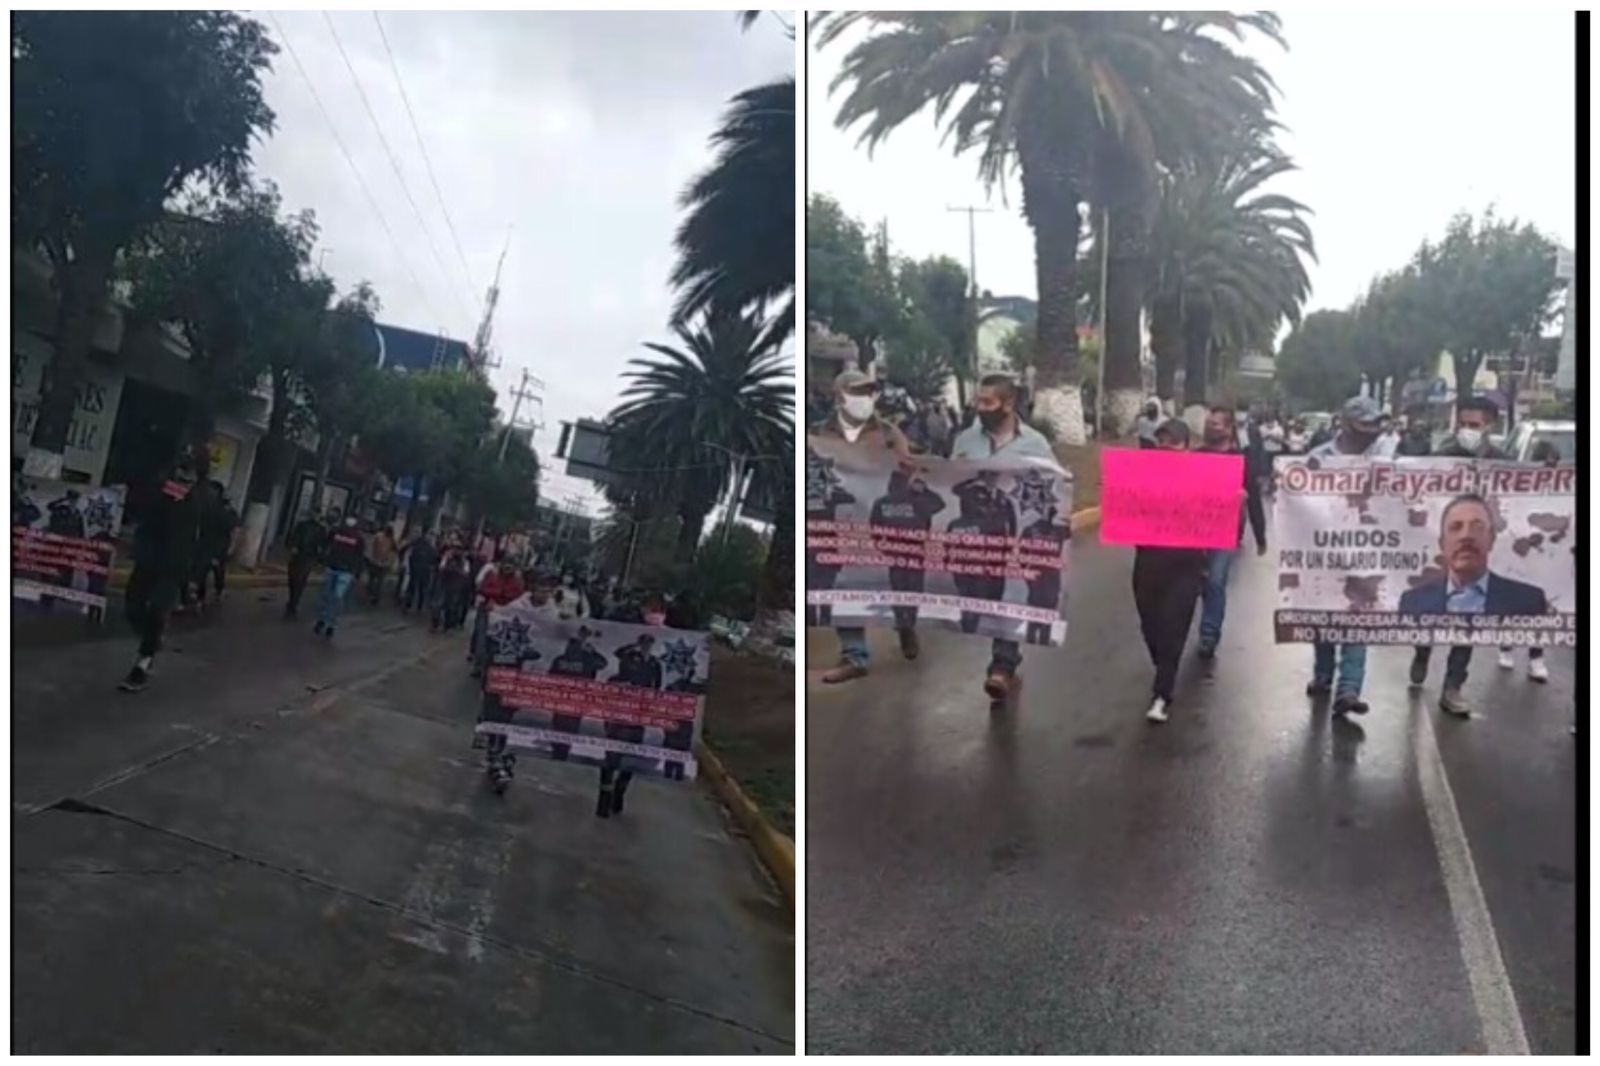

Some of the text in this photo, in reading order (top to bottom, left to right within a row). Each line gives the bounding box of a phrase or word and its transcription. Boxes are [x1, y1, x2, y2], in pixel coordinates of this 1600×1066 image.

[1284, 464, 1369, 494] Omar
[1313, 529, 1401, 548] UNIDOS
[1279, 550, 1303, 569] POR
[1305, 551, 1324, 570] UN
[1326, 551, 1378, 571] SALARIO
[1331, 613, 1399, 627] PROCESAR
[1400, 614, 1418, 626] AL
[1419, 614, 1469, 628] OFICIAL
[1471, 614, 1500, 628] QUE
[1292, 626, 1316, 640] NO
[1318, 627, 1431, 645] TOLERAREMOS
[1470, 629, 1536, 646] ABUSOS
[1539, 630, 1552, 646] A
